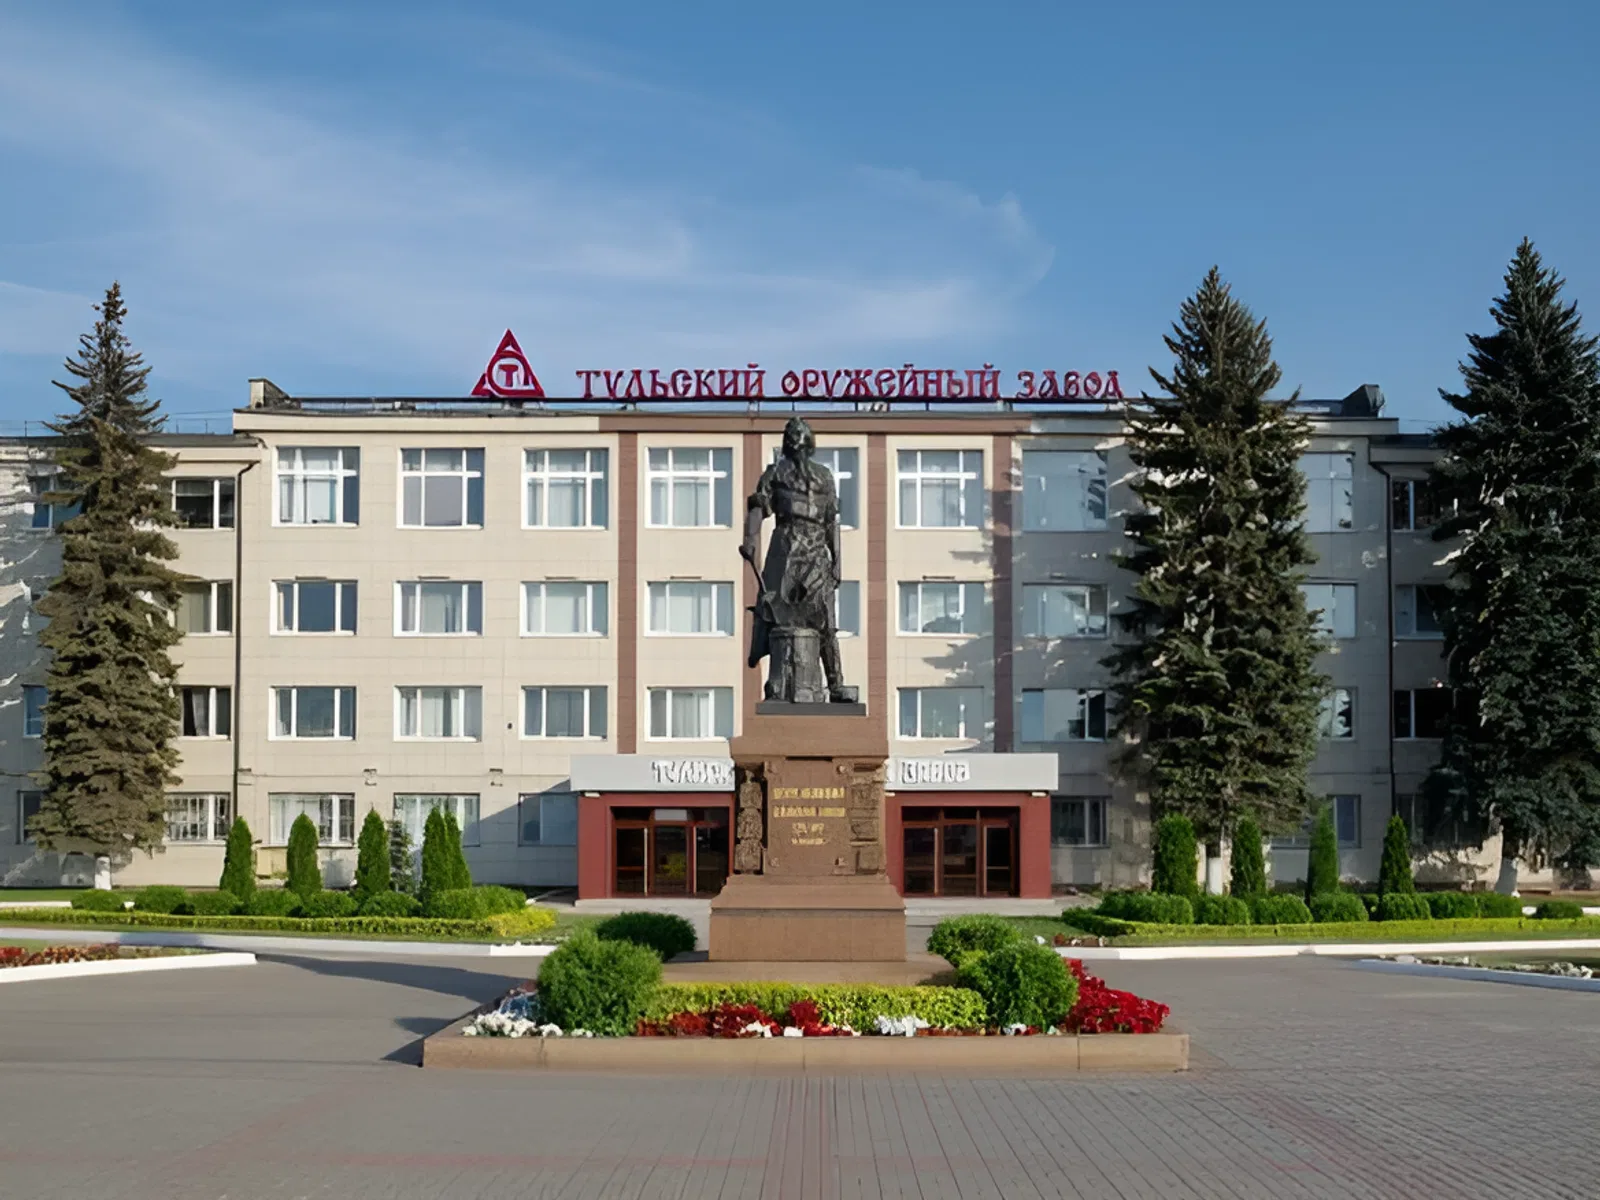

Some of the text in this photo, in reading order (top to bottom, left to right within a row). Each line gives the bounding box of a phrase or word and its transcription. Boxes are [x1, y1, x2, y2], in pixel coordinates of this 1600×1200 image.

[576, 364, 1123, 399] ТУЛЬСКИЙ ОРУЖЕЙНЫЙ ЗАВОД
